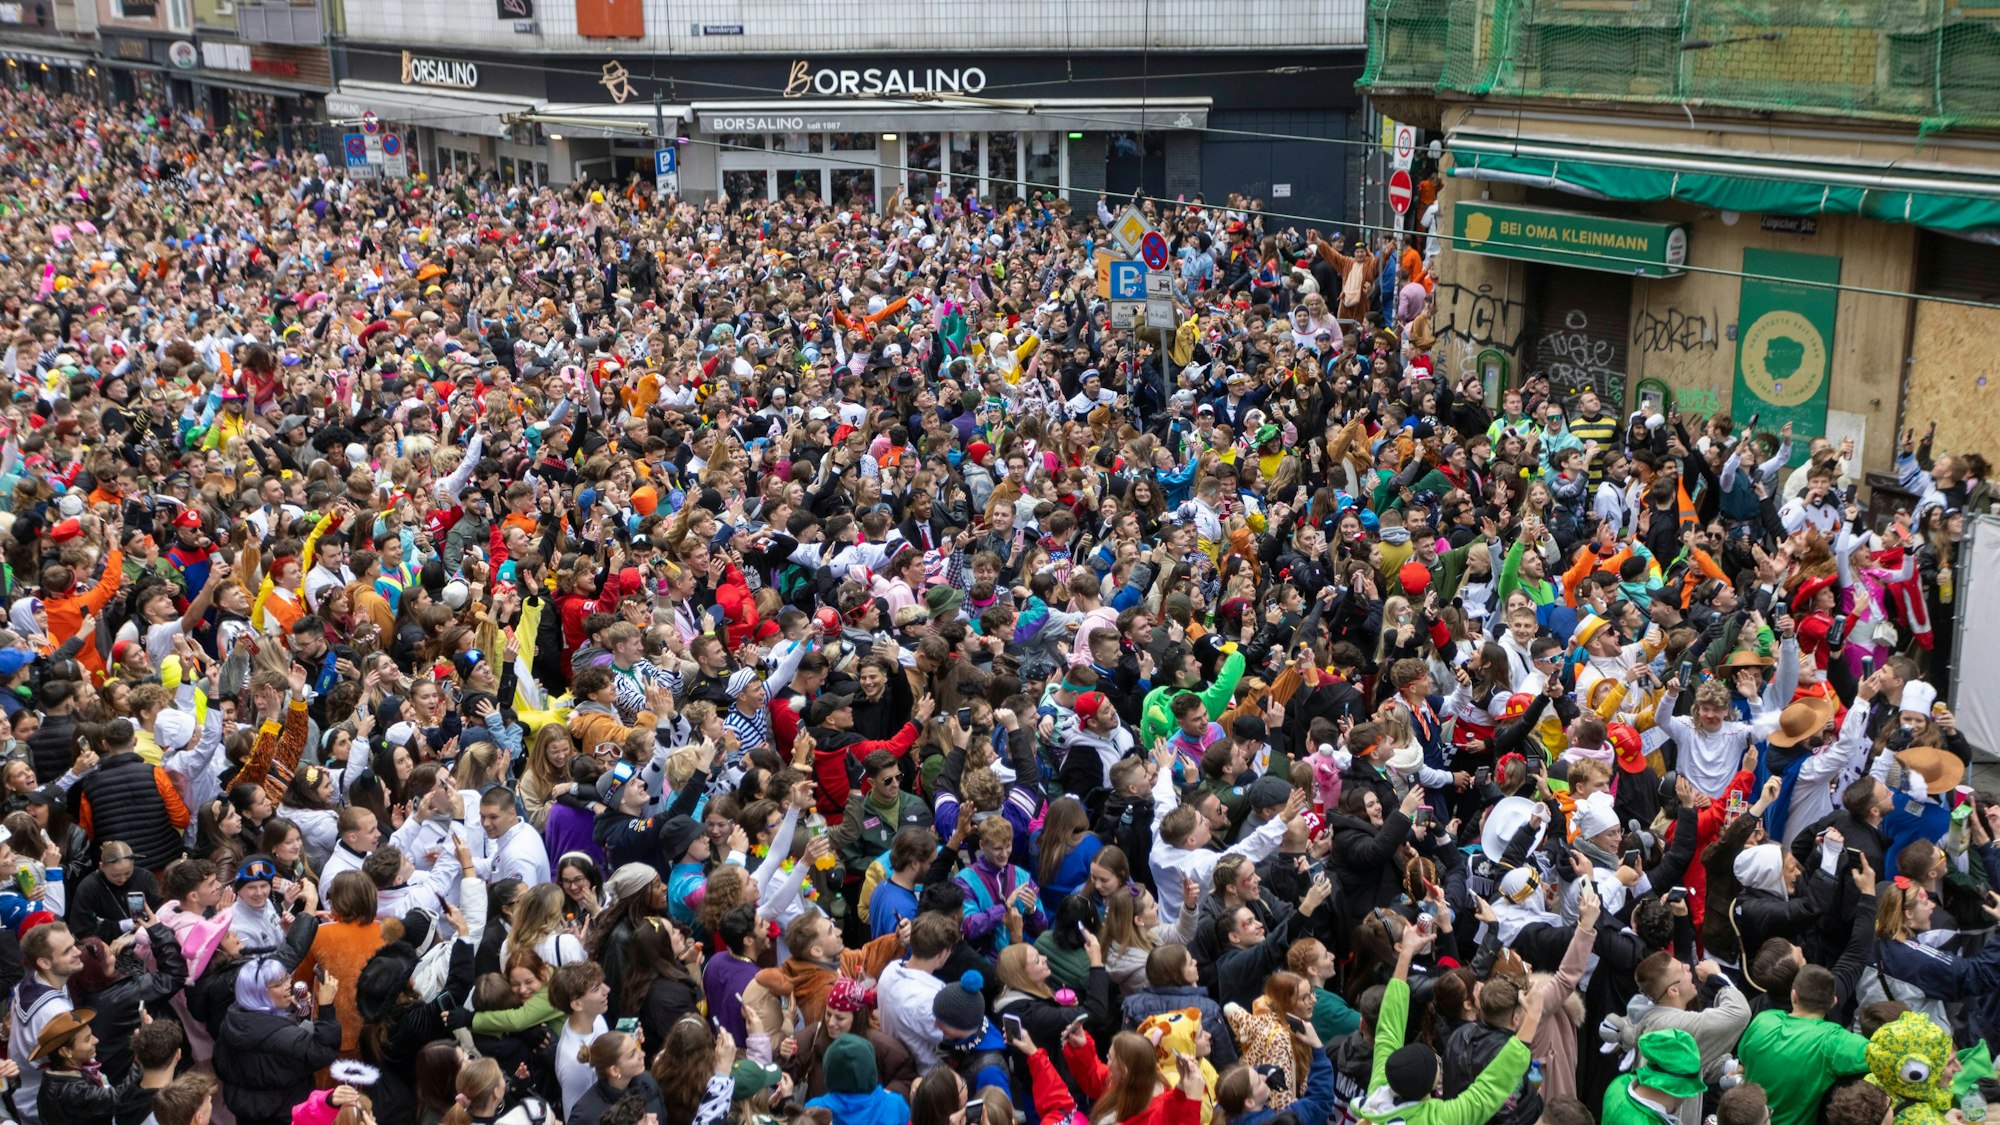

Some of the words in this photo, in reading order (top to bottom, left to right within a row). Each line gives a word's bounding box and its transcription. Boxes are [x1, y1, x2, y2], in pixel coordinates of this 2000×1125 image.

[401, 49, 478, 88] BORSALINO
[783, 59, 987, 98] BORSALINO
[328, 101, 360, 115] BORSALINO
[713, 117, 804, 131] BORSALINO
[822, 122, 841, 130] 1987
[1499, 221, 1522, 237] BEI
[1525, 224, 1558, 242] OMA
[1561, 228, 1649, 252] KLEINMANN
[1119, 266, 1139, 295] P
